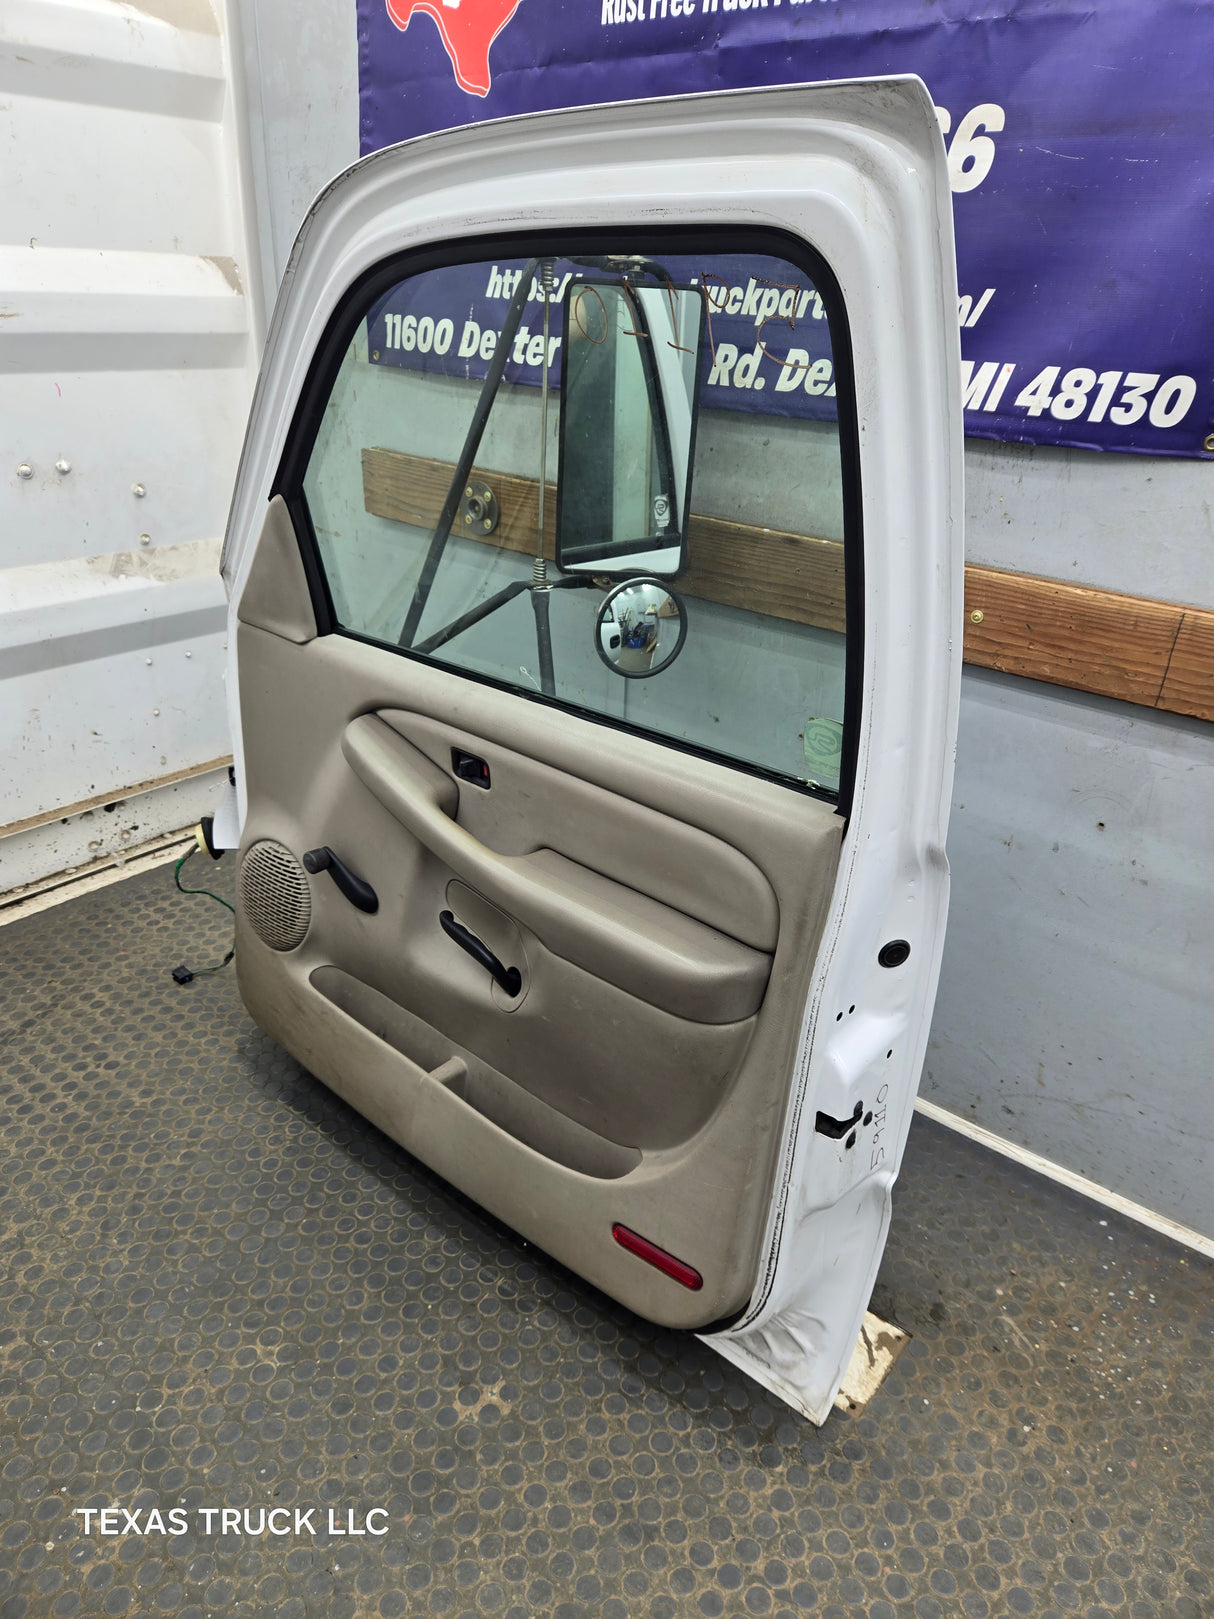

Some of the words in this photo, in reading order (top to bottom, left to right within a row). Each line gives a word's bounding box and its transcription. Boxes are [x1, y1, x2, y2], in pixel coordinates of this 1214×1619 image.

[384, 313, 453, 356] 11600
[458, 320, 562, 368] Deter
[706, 342, 765, 390] Rd.
[1013, 366, 1198, 429] 48130
